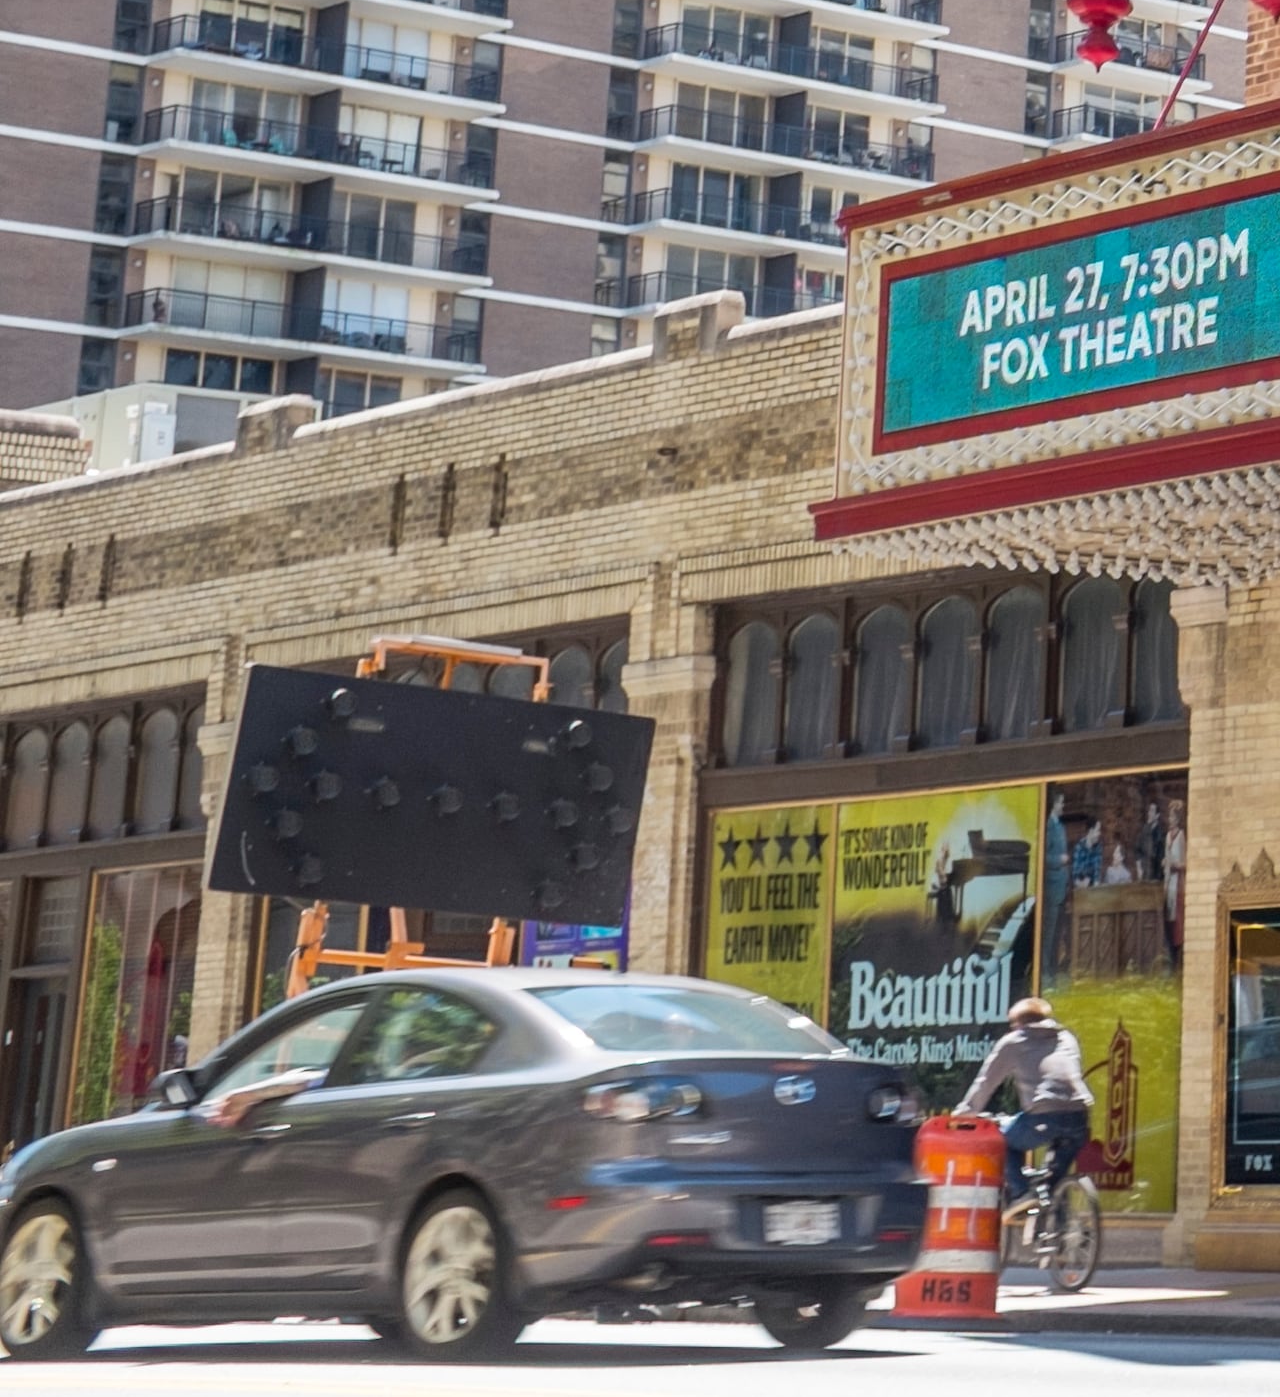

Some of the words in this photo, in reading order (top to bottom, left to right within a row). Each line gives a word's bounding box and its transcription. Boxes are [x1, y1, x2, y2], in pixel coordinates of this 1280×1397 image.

[959, 273, 1056, 337] APRIL
[1064, 261, 1111, 314] 27,
[1120, 228, 1249, 302] 7:30PM
[981, 331, 1050, 390] FOX
[1058, 296, 1219, 373] THEATRE
[765, 873, 795, 911] FEEL
[797, 872, 822, 909] THE
[723, 925, 764, 966] EARTH
[848, 952, 1014, 1030] Beautiful
[847, 1036, 871, 1059] The
[875, 1034, 918, 1065] Carole
[920, 1035, 954, 1070] King
[1244, 1154, 1273, 1172] FOX
